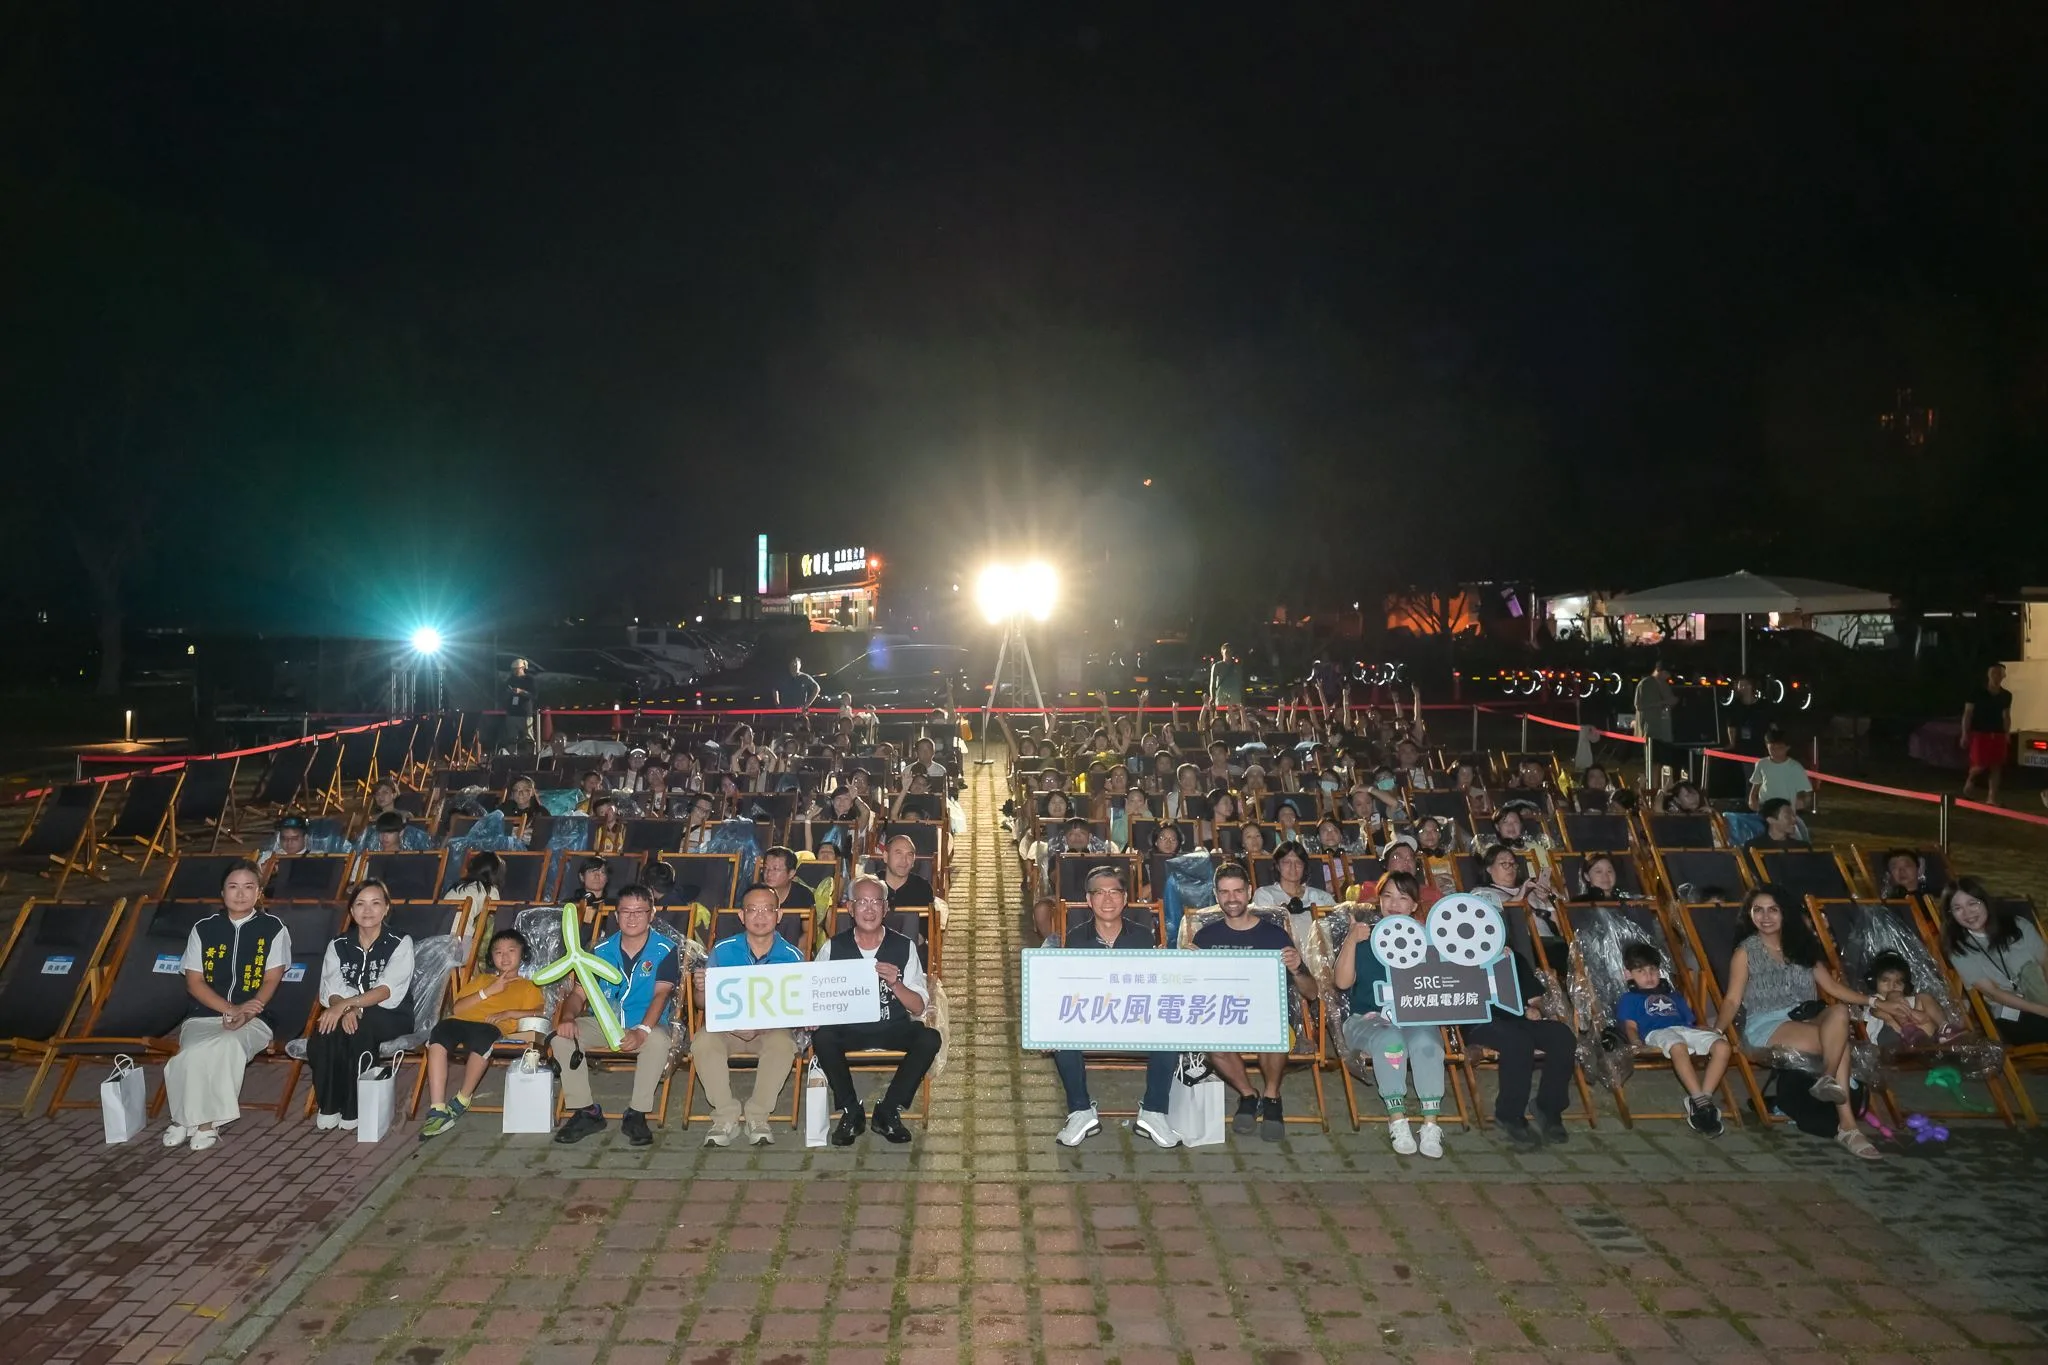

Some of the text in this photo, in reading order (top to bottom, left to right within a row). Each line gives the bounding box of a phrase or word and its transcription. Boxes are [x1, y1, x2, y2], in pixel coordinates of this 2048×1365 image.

[811, 975, 847, 987] Synera
[1109, 973, 1158, 984] 風睿能源
[1413, 976, 1441, 989] SRE
[714, 974, 804, 1020] SRE
[812, 986, 871, 999] Renewable
[1400, 992, 1479, 1008] 吹吹風電影院
[812, 1001, 849, 1013] Energy
[1058, 993, 1251, 1025] 吹吹風電影院
